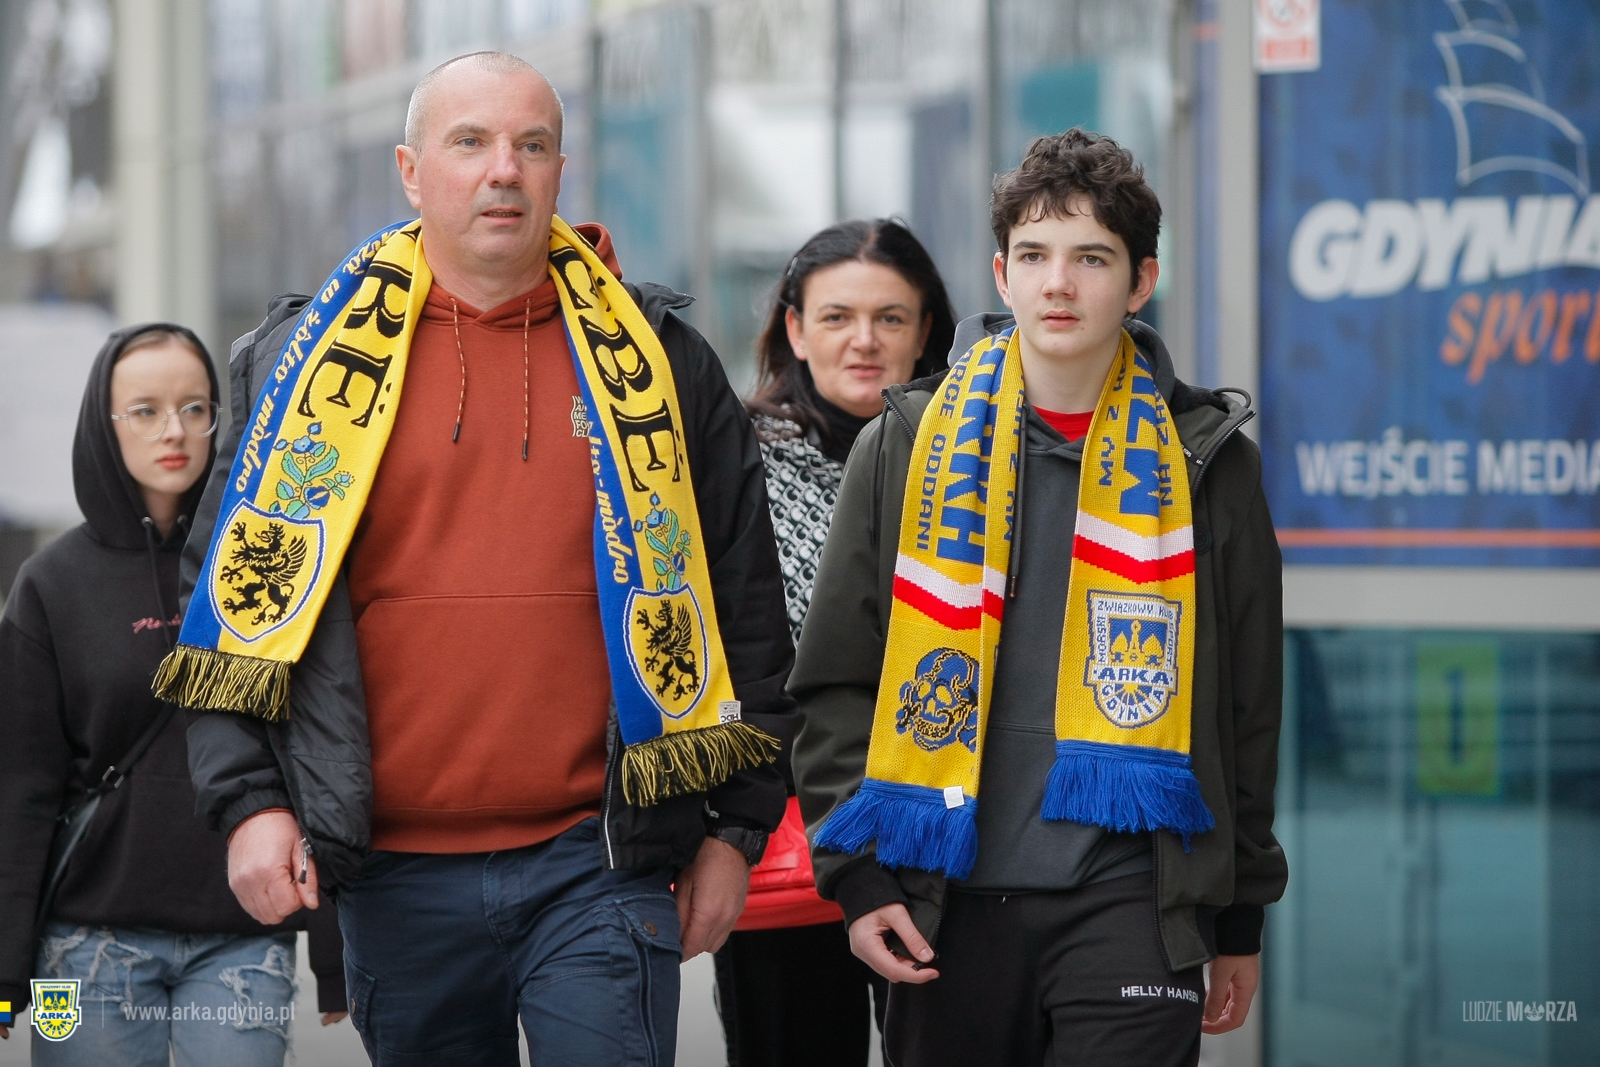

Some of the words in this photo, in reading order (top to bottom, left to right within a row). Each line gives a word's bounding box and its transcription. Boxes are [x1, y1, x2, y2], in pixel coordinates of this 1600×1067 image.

[1106, 404, 1120, 422] Z
[1099, 436, 1115, 487] MY
[1295, 425, 1468, 500] WEJŚCIE
[916, 433, 948, 551] ODDANI
[1096, 614, 1108, 663] MORSKI
[1097, 667, 1170, 686] ARKA
[1121, 985, 1163, 998] HELLY
[1166, 986, 1199, 1004] HANSEN
